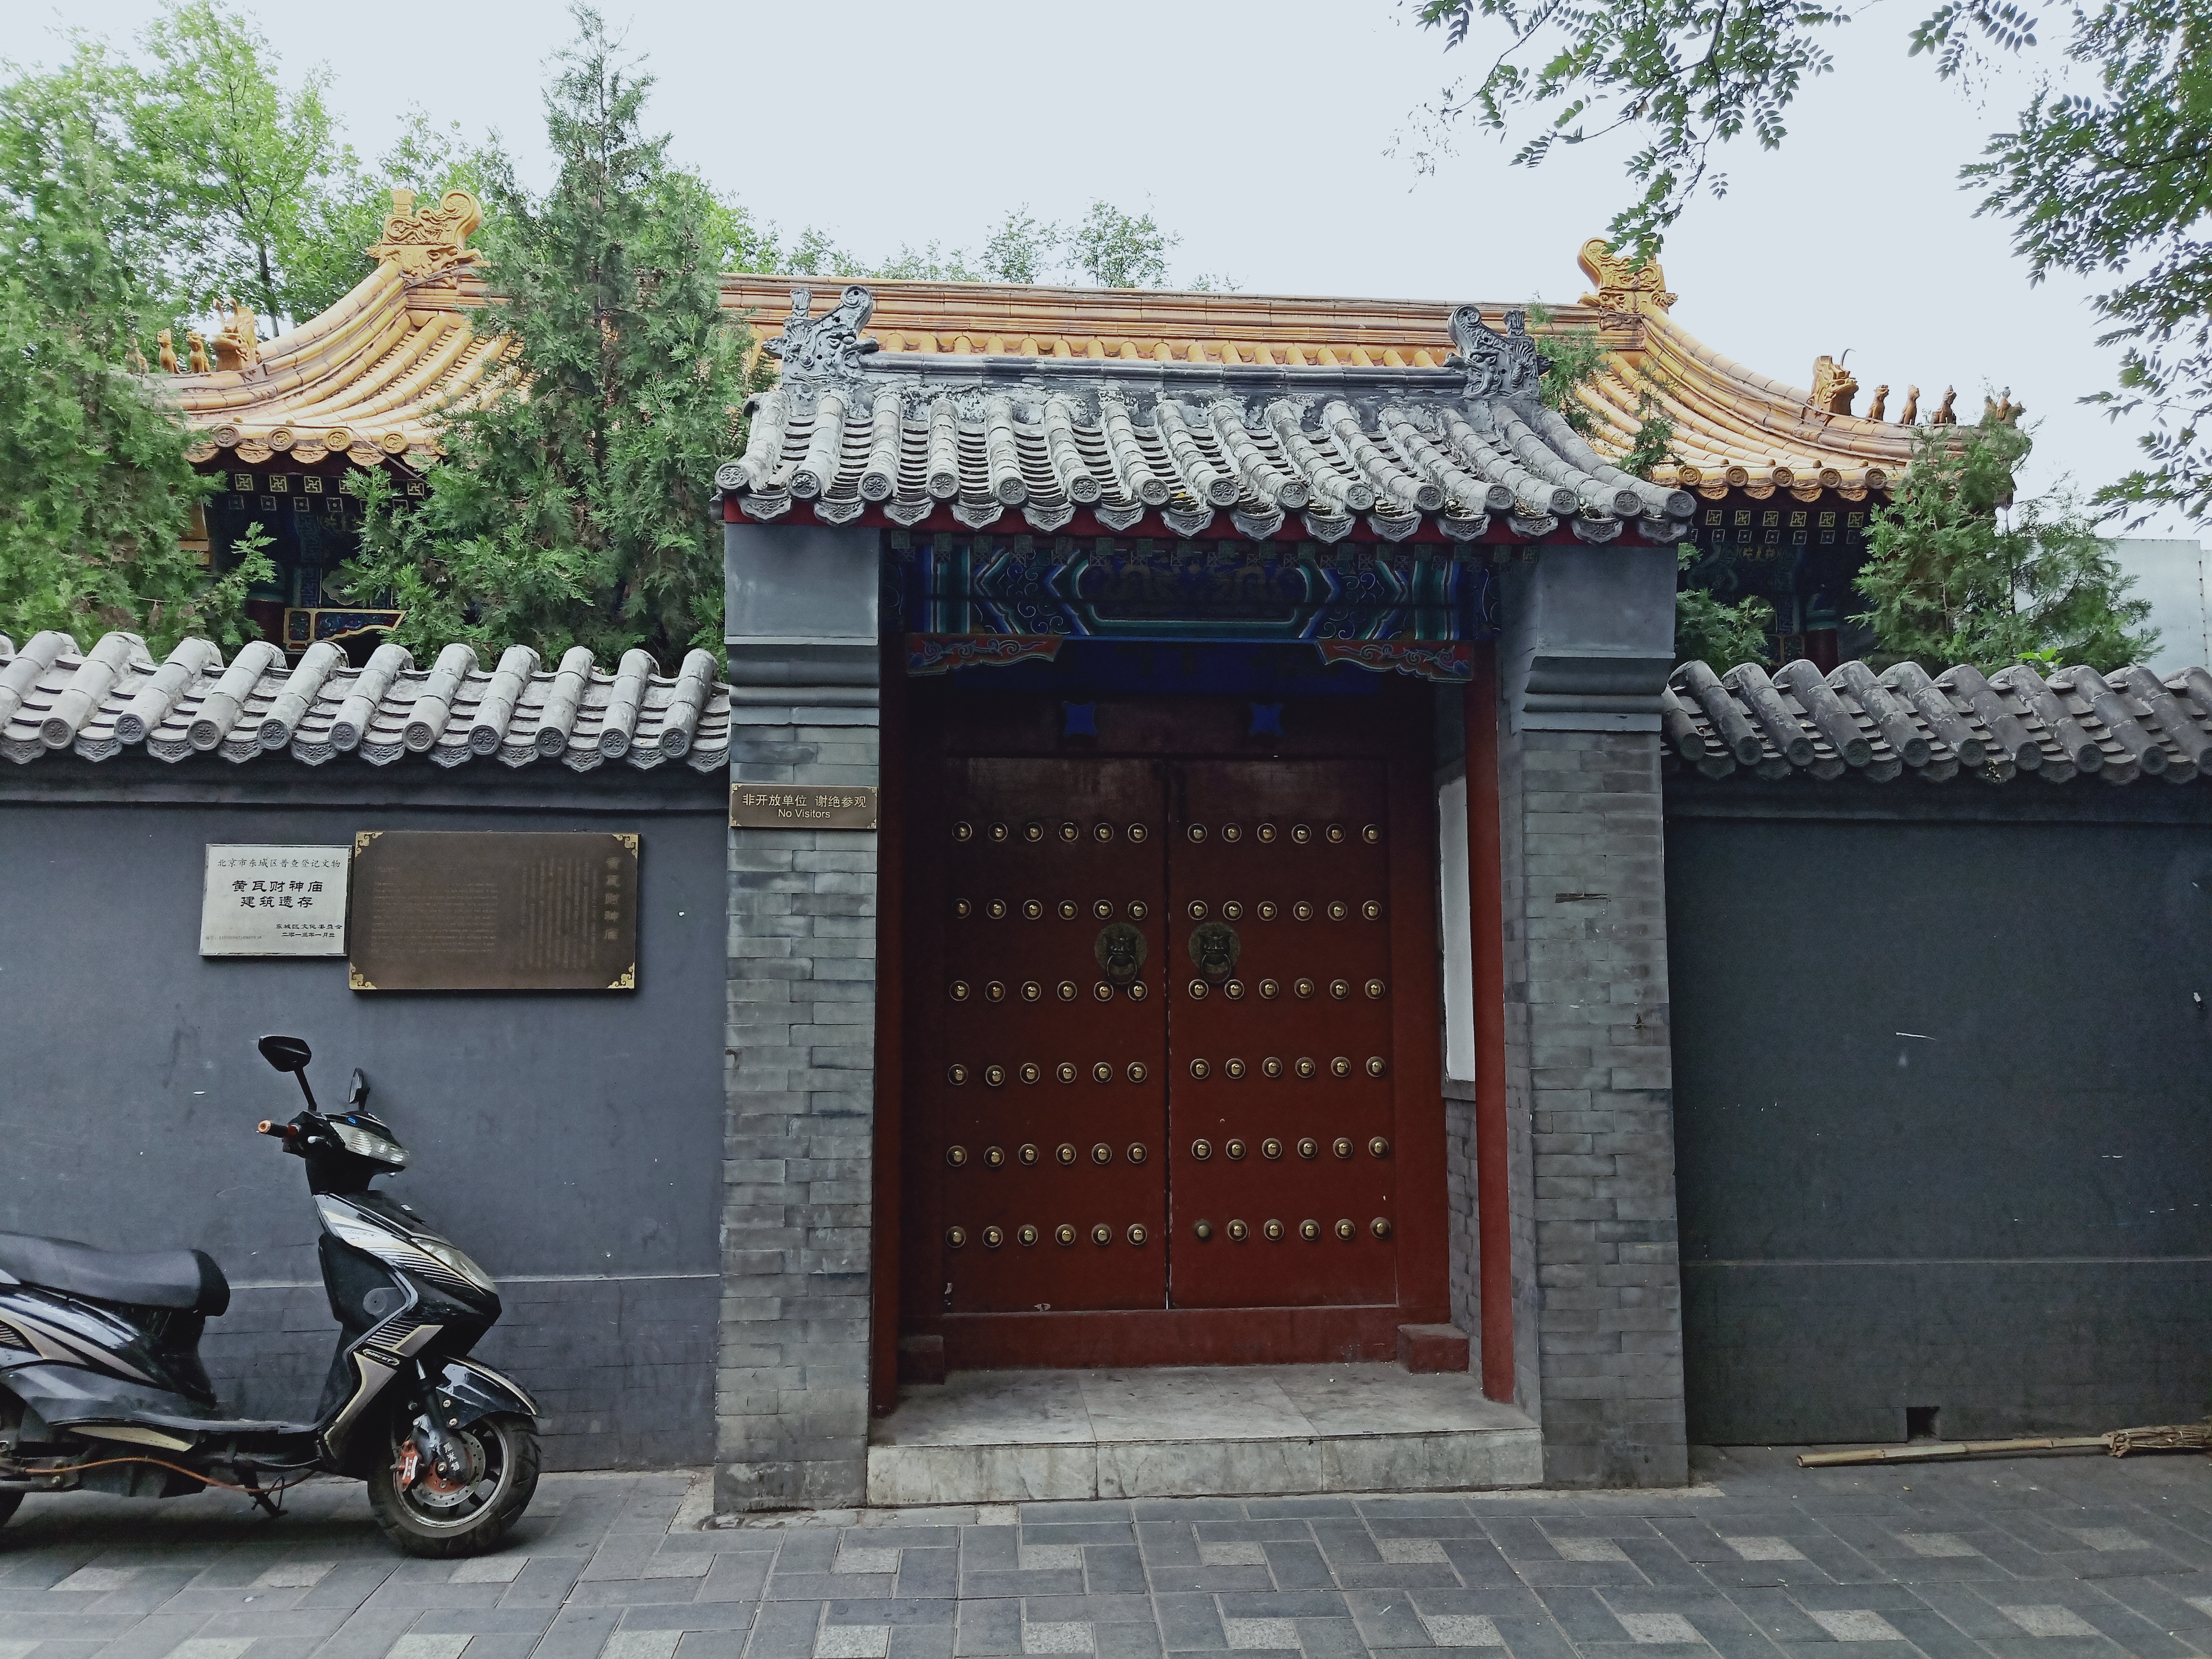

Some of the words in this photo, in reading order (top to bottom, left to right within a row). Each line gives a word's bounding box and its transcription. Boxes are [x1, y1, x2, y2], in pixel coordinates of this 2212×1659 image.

[742, 793, 807, 807] 非开放单位
[815, 795, 866, 808] 谢绝参观
[778, 809, 792, 818] No
[795, 809, 830, 818] Visitors
[217, 858, 341, 868] 北京市东城区普查登记文物
[232, 880, 323, 892] 黄瓦财神庙
[240, 896, 313, 908] 建筑遗存
